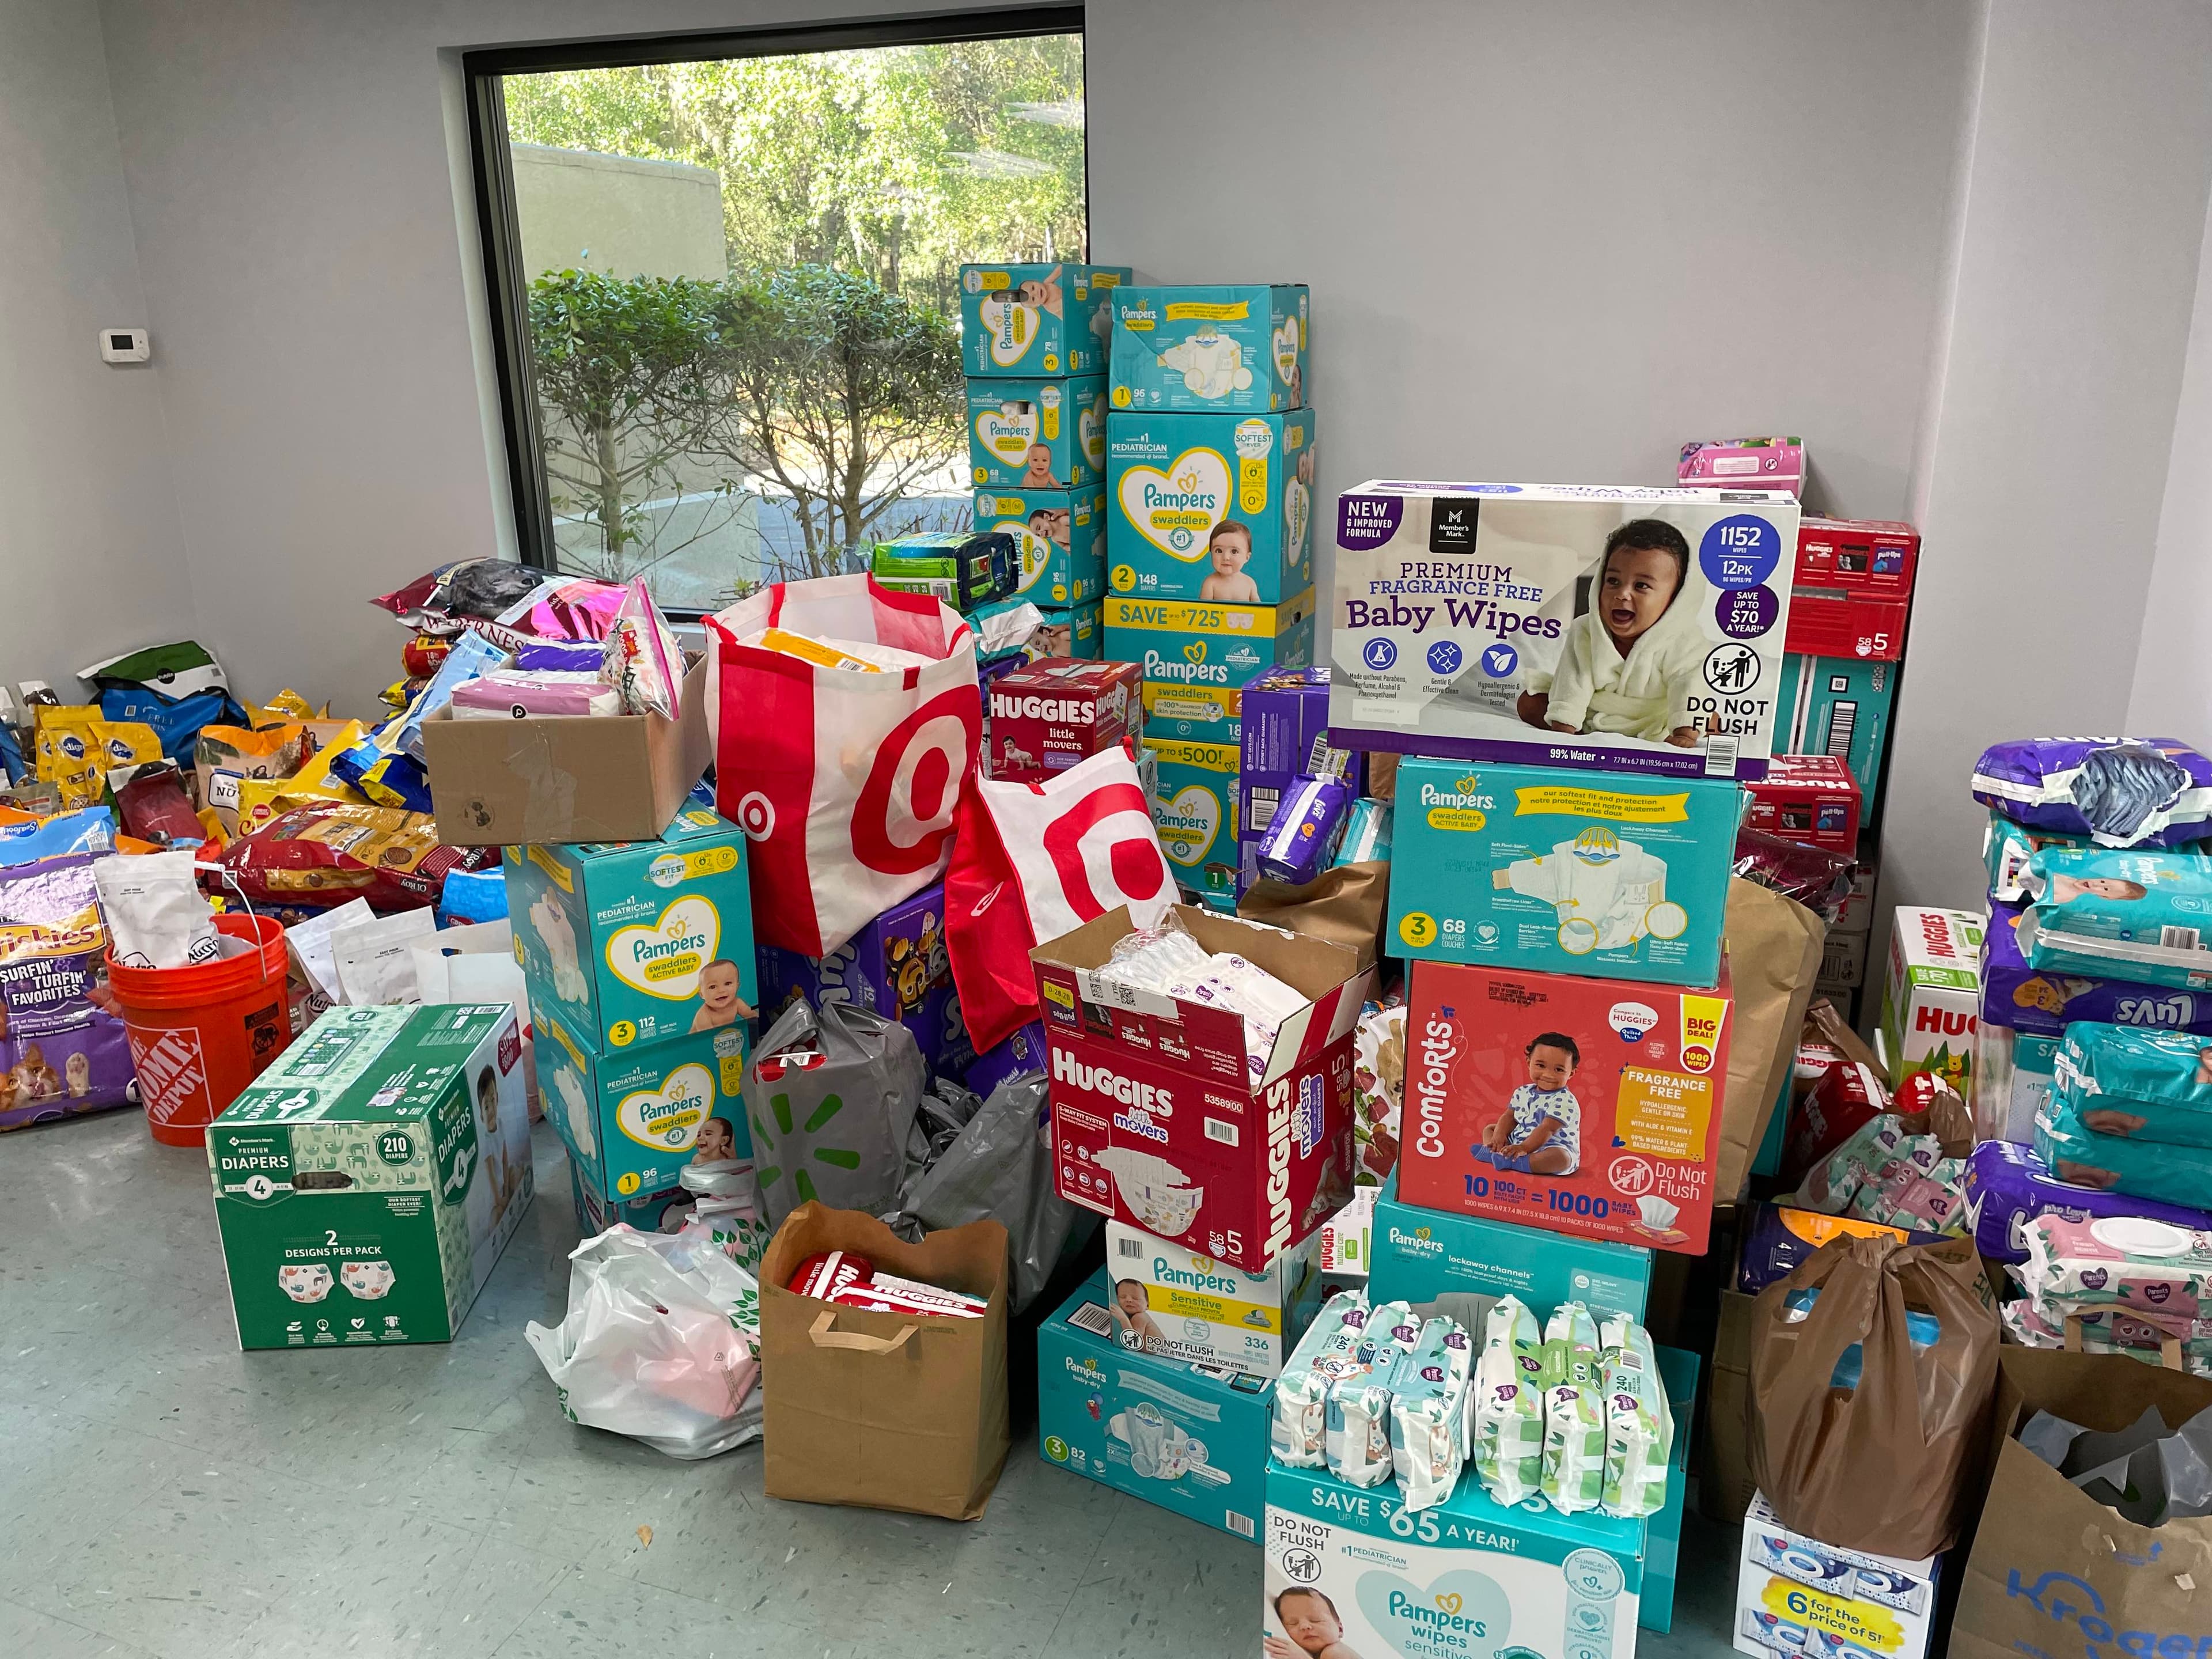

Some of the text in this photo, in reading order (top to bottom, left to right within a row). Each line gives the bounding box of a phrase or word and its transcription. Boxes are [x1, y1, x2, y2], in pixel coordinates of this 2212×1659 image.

[1122, 306, 1157, 320] Pampers
[1000, 304, 1012, 350] Pampers
[990, 421, 1029, 437] Pampers
[1236, 434, 1272, 442] SOFTEST
[1111, 443, 1167, 452] PEDIATRICIAN
[1144, 483, 1215, 512] Pampers
[1348, 501, 1387, 517] NEW
[1152, 515, 1209, 525] swaddlers
[1354, 519, 1392, 528] IMPROVED
[1439, 524, 1469, 532] Member's
[1346, 528, 1381, 538] FORMULA
[1720, 527, 1762, 547] 1152
[1119, 567, 1158, 585] 2 148
[1401, 562, 1512, 583] PREMIUM
[1722, 559, 1753, 576] 12PK
[1369, 579, 1543, 603] FRAGRANCE FREE
[1736, 592, 1759, 600] SAVE
[1734, 600, 1759, 609] UP TO
[1120, 605, 1168, 625] SAVE
[1346, 596, 1562, 640] Baby Wipes
[1730, 609, 1759, 624] $70
[1857, 633, 1888, 651] 58 5
[1145, 650, 1228, 684] Pampers
[1157, 688, 1213, 700] swaddlers
[991, 693, 1094, 724] HUGGIES
[1687, 696, 1769, 716] DO NOT
[1050, 728, 1075, 739] little
[1692, 716, 1758, 735] FLUSH
[1043, 739, 1083, 751] movers
[1550, 748, 1596, 762] 99% Water
[1421, 783, 1493, 810] Pampers
[1552, 798, 1591, 809] protection
[1624, 805, 1666, 813] ajustement
[1559, 790, 1586, 799] softest
[1599, 794, 1613, 802] and
[1615, 797, 1657, 806] protection
[1155, 808, 1208, 830] Pampers
[1432, 813, 1482, 822] swaddlers
[1586, 806, 1603, 816] plus
[1604, 808, 1623, 816] doux
[1434, 819, 1459, 828] ACTIVE
[1160, 830, 1203, 842] swaddlers
[650, 864, 685, 877] SOFTEST
[597, 900, 655, 919] PEDIATRICIAN
[1411, 916, 1465, 935] 3 68
[1442, 933, 1465, 942] DIAPERS
[1442, 940, 1465, 950] COUCHES
[1919, 913, 1956, 959] HUGGIES
[633, 934, 706, 963] Pampers
[648, 956, 697, 972] swaddlers
[652, 964, 695, 979] ACTIVE BABY
[12, 983, 81, 1006] FAVORITES
[1613, 1014, 1653, 1026] HUGGIES
[2116, 994, 2192, 1031] Luvs
[616, 1016, 656, 1039] 3 112
[1687, 1017, 1716, 1032] BIG
[1687, 1029, 1713, 1039] DEAL!
[1686, 1052, 1709, 1063] 1000
[1687, 1059, 1707, 1069] WIPES
[607, 1070, 658, 1089] PEDIATRICIAN
[1052, 1047, 1173, 1117] HUGGIES
[1628, 1071, 1706, 1092] FRAGRANCE
[152, 1065, 204, 1124] DEPOT
[1650, 1087, 1681, 1100] FREE
[640, 1096, 702, 1123] Pampers
[649, 1114, 698, 1133] swaddlers
[1114, 1112, 1168, 1142] movers
[383, 1137, 407, 1153] 210
[222, 1156, 289, 1171] DIAPERS
[1264, 1078, 1291, 1271] HUGGIES
[1656, 1162, 1707, 1185] Do Not
[254, 1180, 266, 1195] 4
[1464, 1174, 1609, 1219] 10 1000
[1658, 1180, 1700, 1201] Flush
[324, 1230, 338, 1245] 2
[1209, 1229, 1243, 1255] 58 5
[1389, 1227, 1444, 1253] Pampers
[285, 1246, 382, 1258] DESIGNS PER PACK
[1321, 1227, 1334, 1270] HUGGIES
[1402, 1247, 1431, 1259] baby-dry
[1153, 1257, 1236, 1294] Pampers
[1448, 1255, 1531, 1279] lockaway channels
[873, 1285, 968, 1309] HUGGIES
[1171, 1292, 1222, 1310] Sensitive
[1147, 1335, 1214, 1357] DO NOT FLUSH
[1244, 1336, 1269, 1350] 336
[1156, 1347, 1168, 1355] PAS
[1169, 1350, 1186, 1358] JETER
[1187, 1353, 1205, 1362] DANS
[1217, 1359, 1249, 1371] TOILETTES
[1065, 1356, 1107, 1382] Pampers
[1072, 1374, 1101, 1389] baby-dry
[1616, 1375, 1627, 1392] 240
[1052, 1440, 1086, 1461] 3 82
[1311, 1487, 1370, 1517] SAVE
[1380, 1500, 1440, 1543] $65
[1446, 1528, 1459, 1539] A
[1274, 1516, 1331, 1539] DO NOT
[1279, 1531, 1324, 1551] FLUSH
[1353, 1546, 1407, 1565] PEDIATRICIAN
[1389, 1590, 1487, 1638] Pampers
[1787, 1592, 1860, 1624] 6 for the
[1809, 1611, 1846, 1631] price
[1850, 1627, 1866, 1637] of
[1411, 1624, 1467, 1649] wipes
[1404, 1639, 1473, 1659] sensitive
